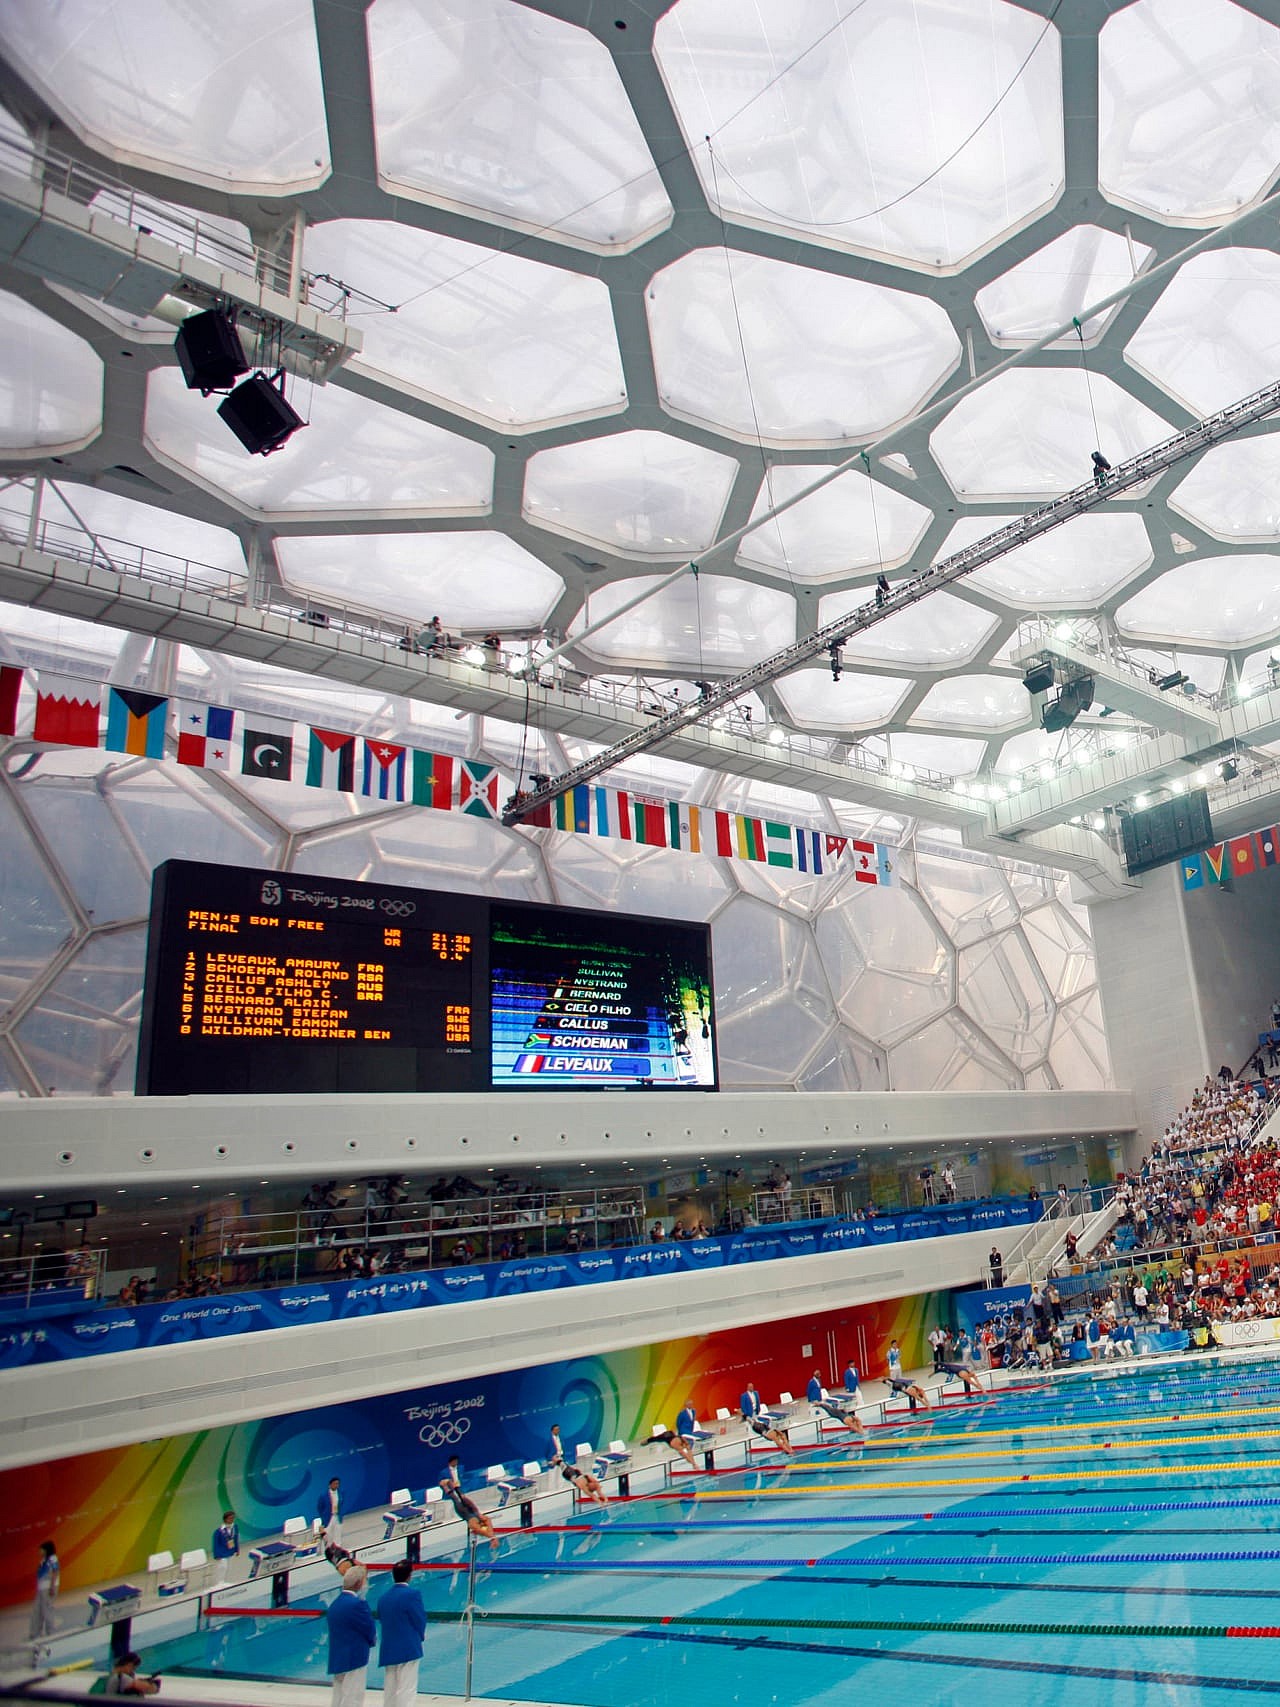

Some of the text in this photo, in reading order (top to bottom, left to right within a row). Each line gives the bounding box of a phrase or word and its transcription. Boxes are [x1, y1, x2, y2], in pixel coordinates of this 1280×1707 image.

[287, 888, 375, 910] Beijing 2008
[188, 910, 324, 931] MEN'S 50M FREE
[188, 921, 238, 934] FINAL
[384, 928, 401, 938] WR
[384, 938, 401, 947] OR
[187, 952, 384, 973] 1 LEVEAUX AMAURY FRA
[185, 962, 384, 982] 2 SCHOEMAN ROLAND RSA
[578, 968, 624, 978] SULLIVAN
[184, 972, 384, 992] 3 CALLUS ASHLEY AUS
[574, 978, 628, 989] NYSTRAND
[183, 983, 384, 1001] 4 CIELO FILHO C. BRA
[569, 990, 622, 1001] BERNARD
[182, 994, 470, 1014] 5 BERNARD ALAIN FRA
[564, 1003, 632, 1016] CIELO FILHO
[182, 1004, 470, 1024] 6 NYSTRAND STEFAN SWE
[182, 1014, 470, 1032] 7 SULLIVAN EAMON AUS
[559, 1018, 609, 1030] CALLUS
[180, 1025, 470, 1042] 8 WILDMAN-TOBRINER BEN USA
[552, 1036, 628, 1050] SCHOEMAN
[544, 1057, 613, 1072] LEVEAUX
[160, 1303, 262, 1323] One World One Dream
[402, 1395, 485, 1420] Beijing 2008
